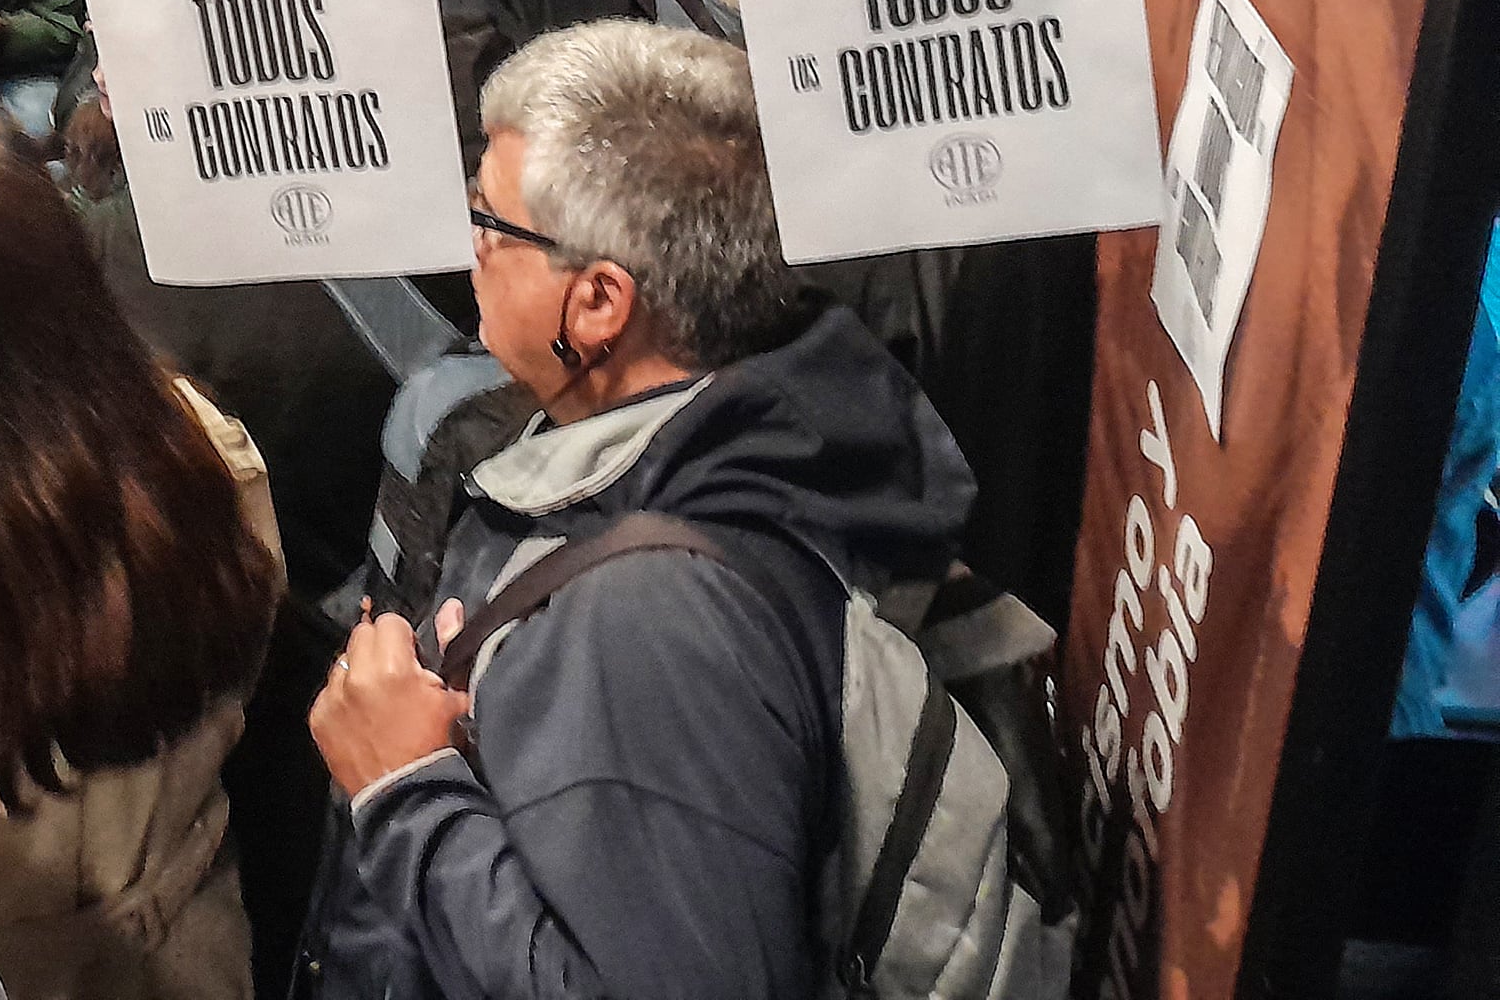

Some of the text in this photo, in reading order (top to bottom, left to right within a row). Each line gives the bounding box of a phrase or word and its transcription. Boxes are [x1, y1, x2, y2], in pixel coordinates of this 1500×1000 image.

[837, 16, 1072, 135] CONTRATOS
[186, 90, 391, 182] CONTRATOS
[1140, 379, 1178, 510] y
